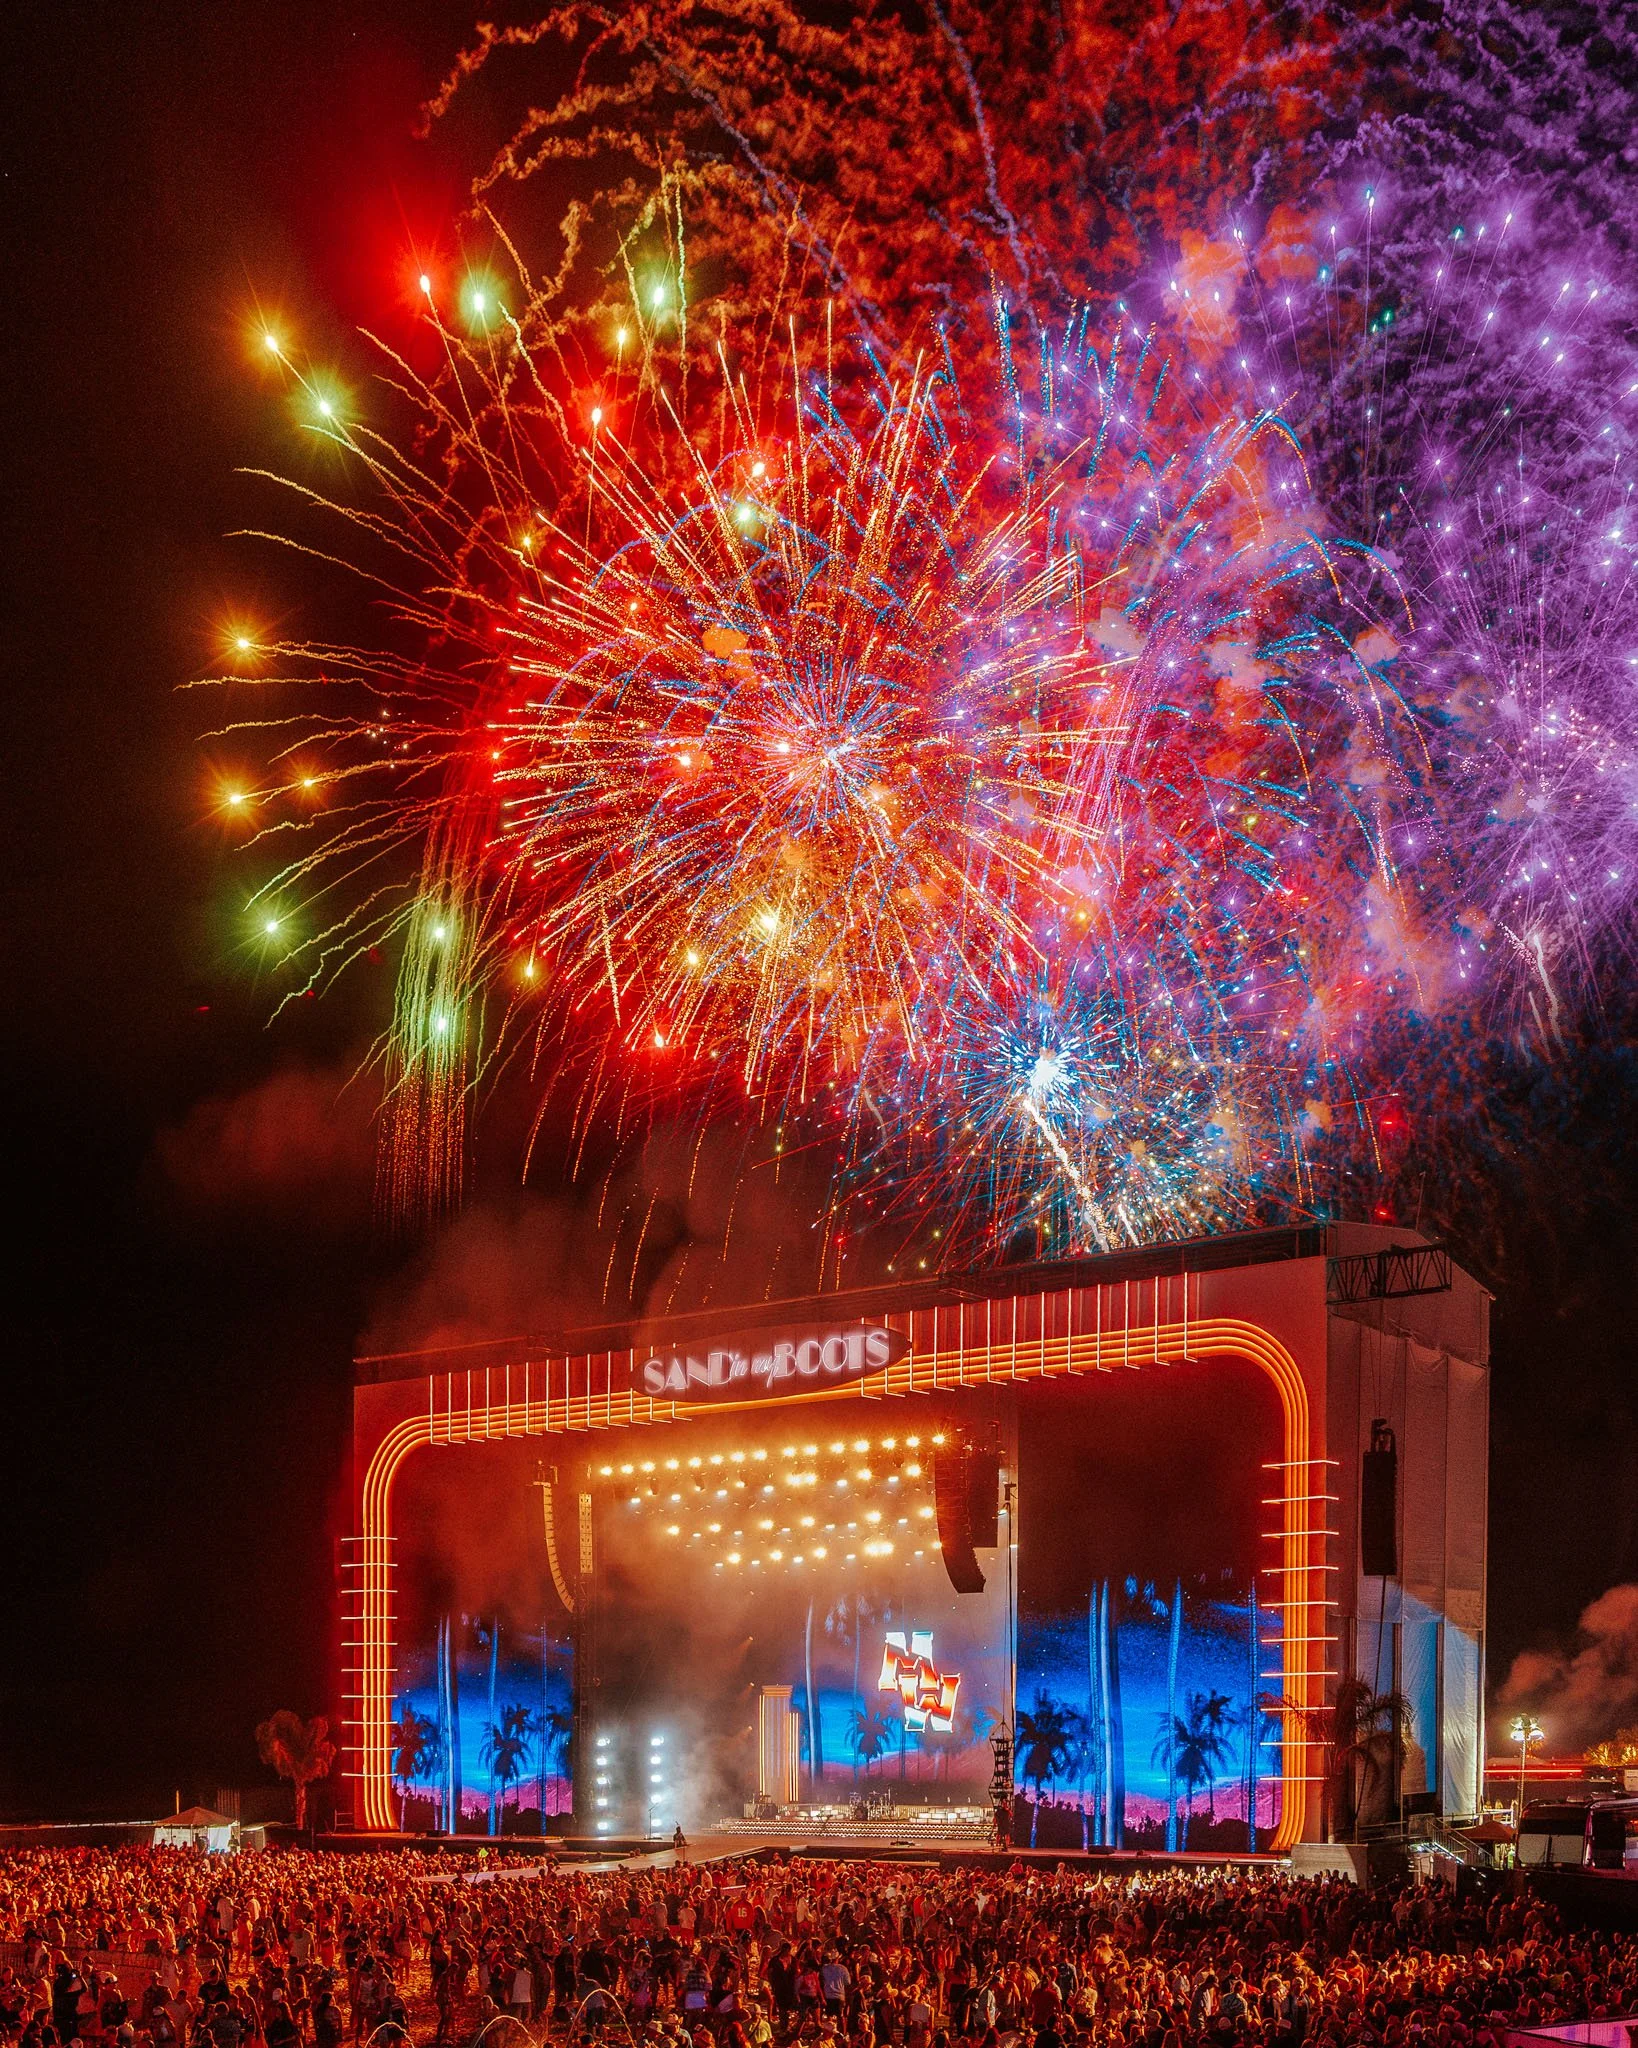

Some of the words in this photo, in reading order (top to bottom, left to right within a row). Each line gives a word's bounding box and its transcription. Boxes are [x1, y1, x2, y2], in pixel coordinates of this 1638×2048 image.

[643, 1351, 733, 1394] SAND
[730, 1352, 748, 1377] in
[751, 1355, 779, 1388] my
[774, 1330, 890, 1378] BOOTS
[737, 1907, 748, 1919] 16
